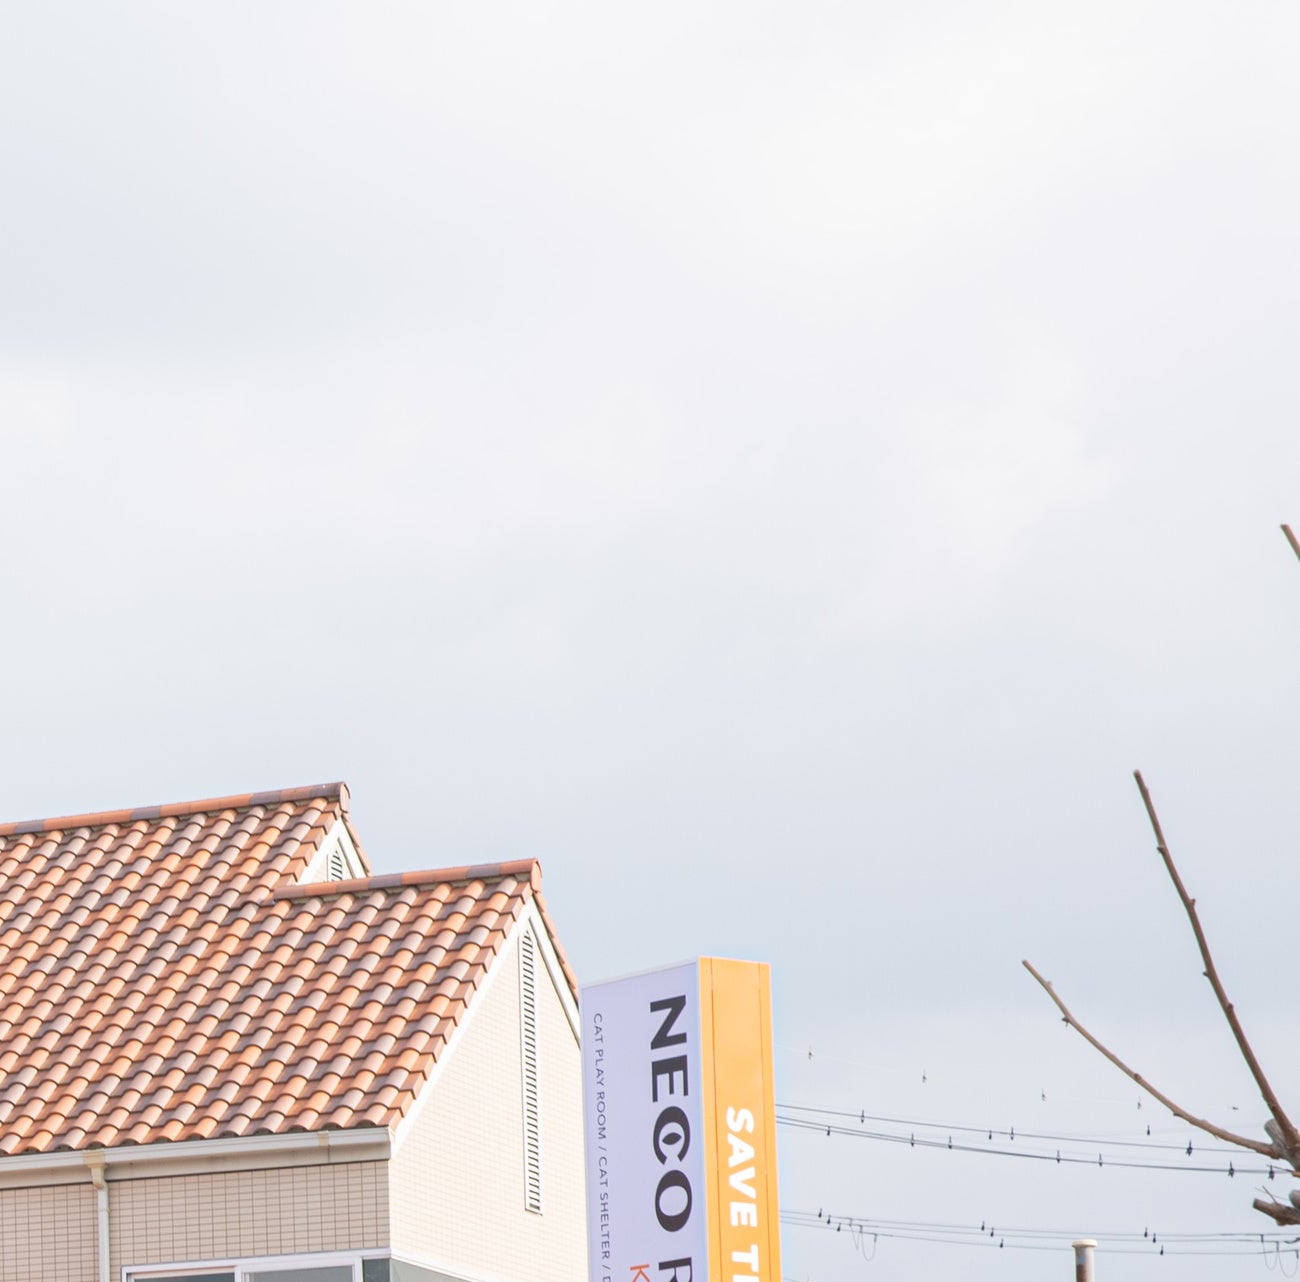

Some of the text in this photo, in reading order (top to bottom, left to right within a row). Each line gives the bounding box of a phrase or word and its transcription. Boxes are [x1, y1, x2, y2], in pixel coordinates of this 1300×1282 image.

[593, 1012, 604, 1043] CAT
[595, 1048, 605, 1086] PLAY
[596, 1091, 607, 1140] ROOM
[598, 1156, 608, 1187] CAT
[725, 1105, 758, 1228] SAVE
[599, 1192, 611, 1260] SHELTER
